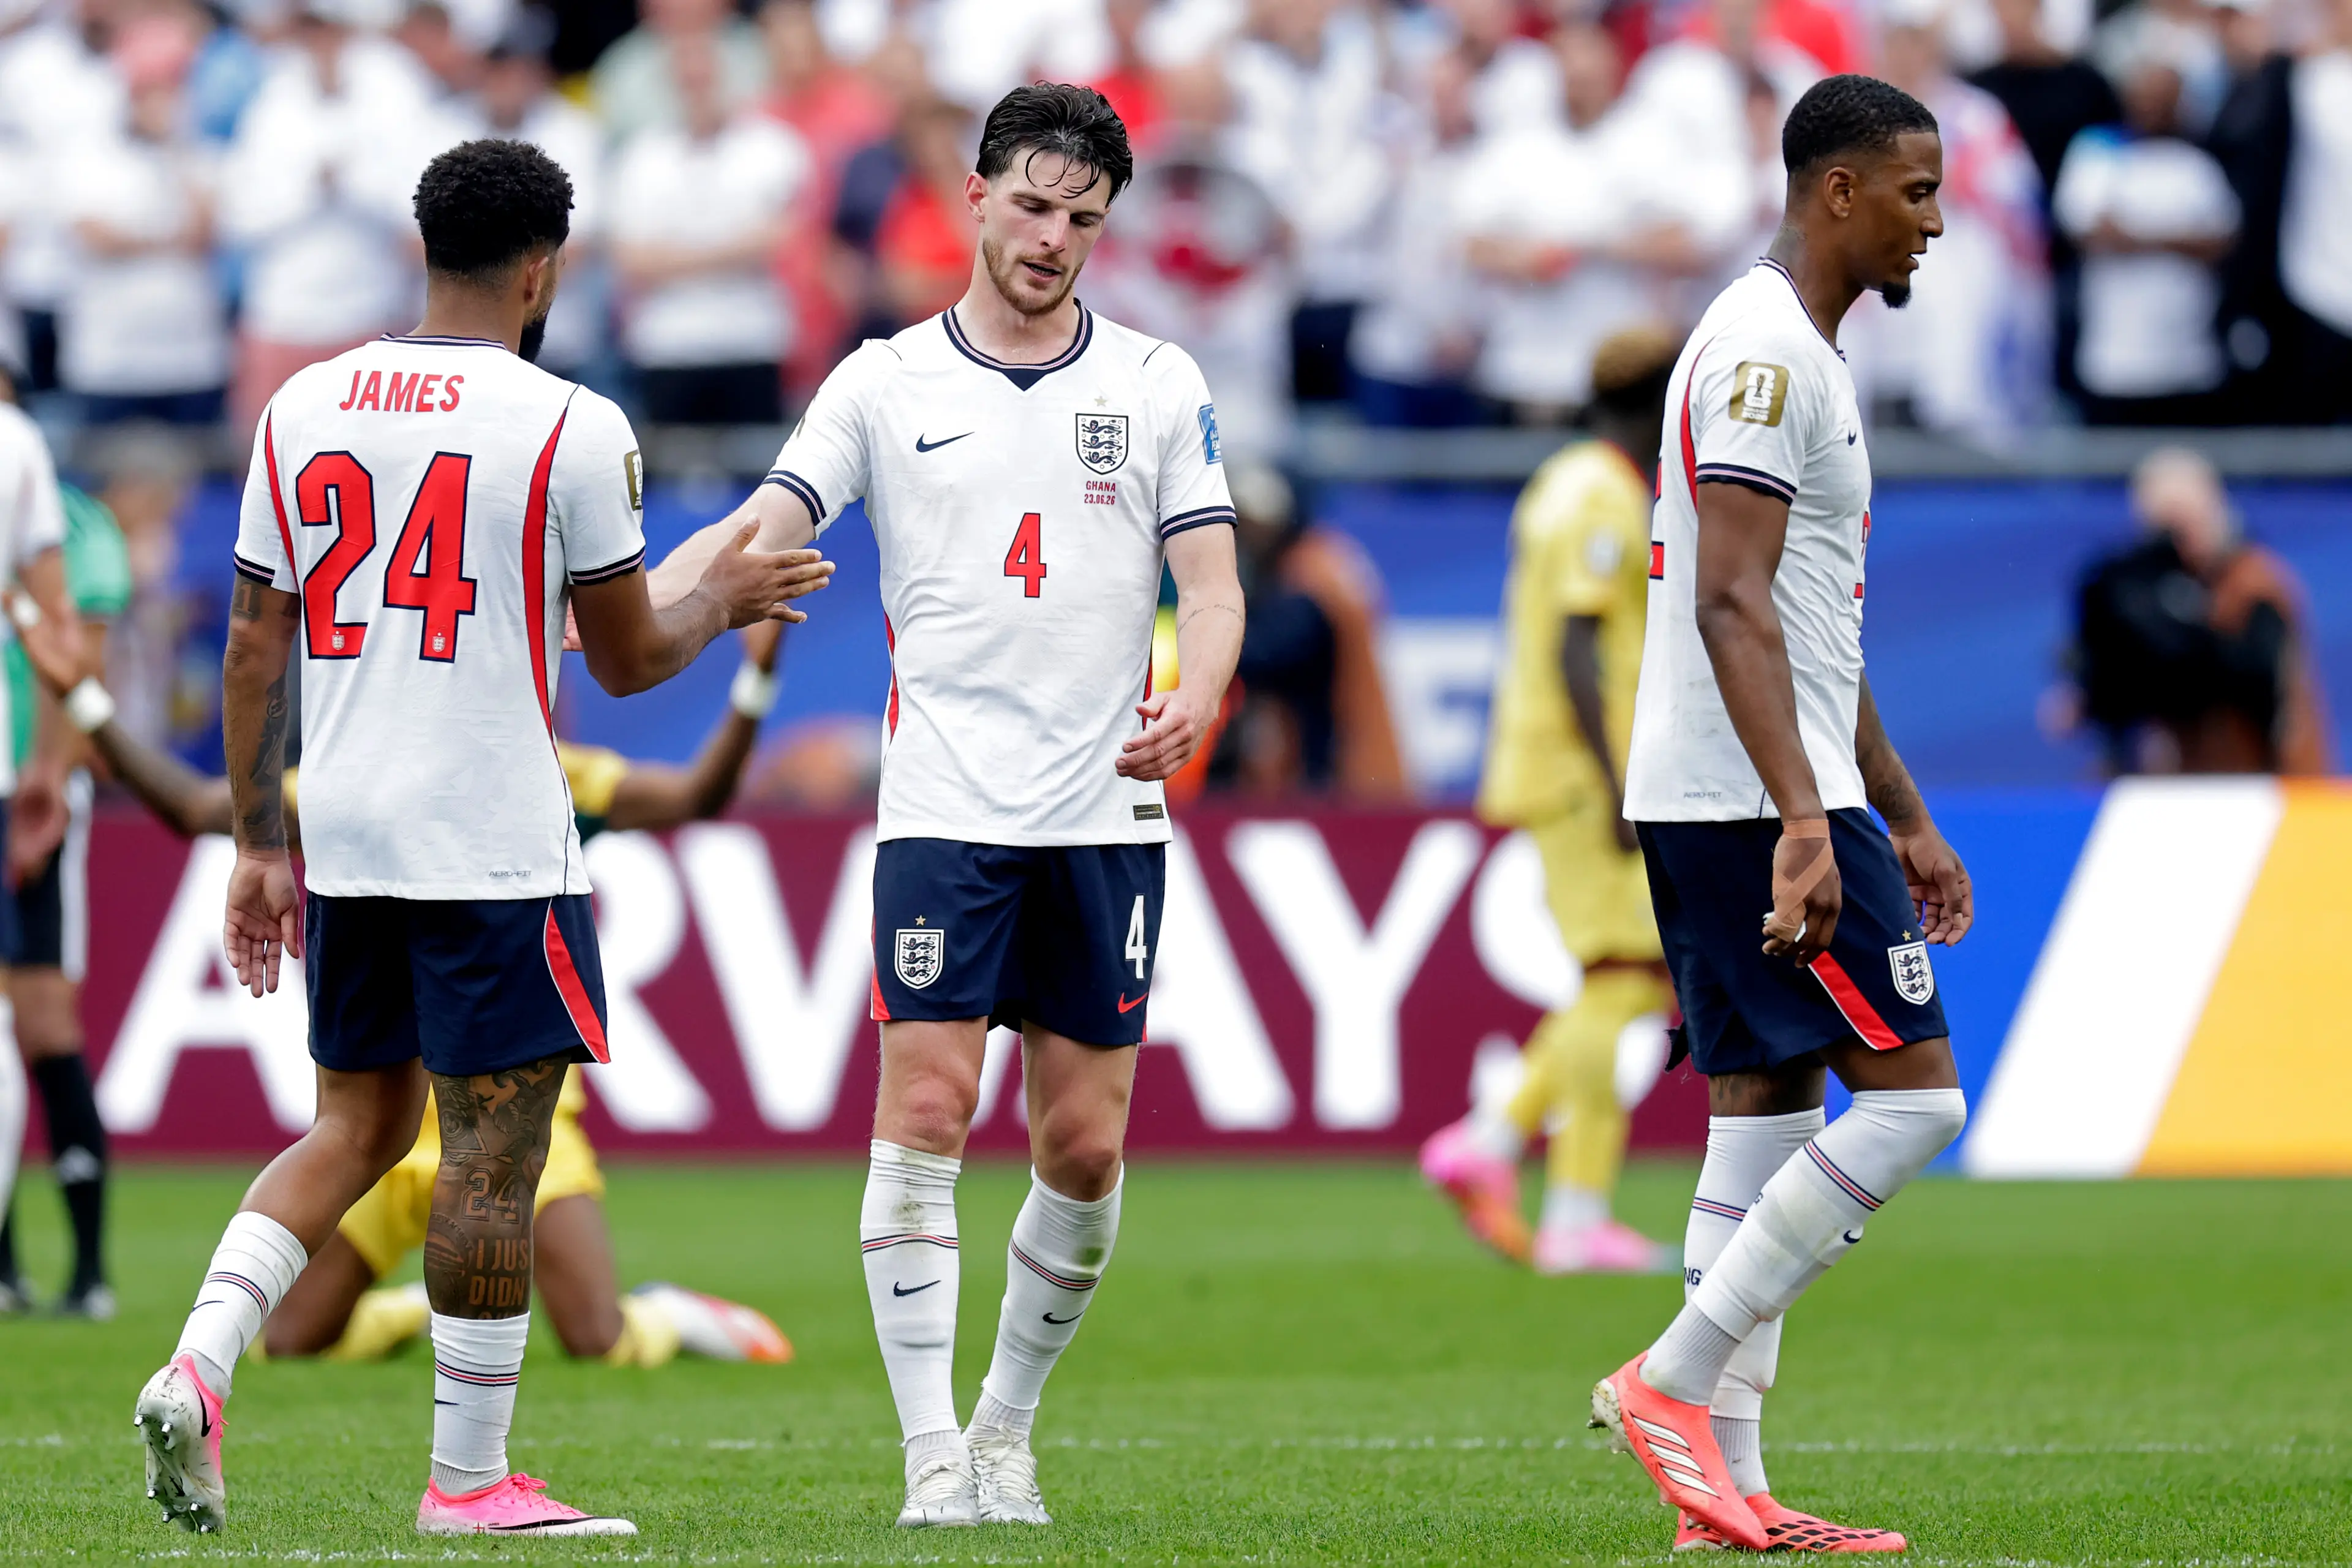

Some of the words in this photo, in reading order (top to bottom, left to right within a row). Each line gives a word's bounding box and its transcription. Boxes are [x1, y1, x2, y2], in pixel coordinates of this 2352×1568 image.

[339, 370, 464, 412] JAMES
[1084, 494, 1116, 505] 23.06.26
[1086, 480, 1116, 492] GHANA
[295, 451, 477, 663] 24
[1004, 512, 1047, 598] 4
[1125, 894, 1148, 980] 4
[97, 823, 1671, 1132] ARWAYS
[461, 1168, 521, 1224] 24
[475, 1238, 485, 1270] I
[491, 1238, 529, 1271] JUS
[469, 1276, 526, 1307] DIDN
